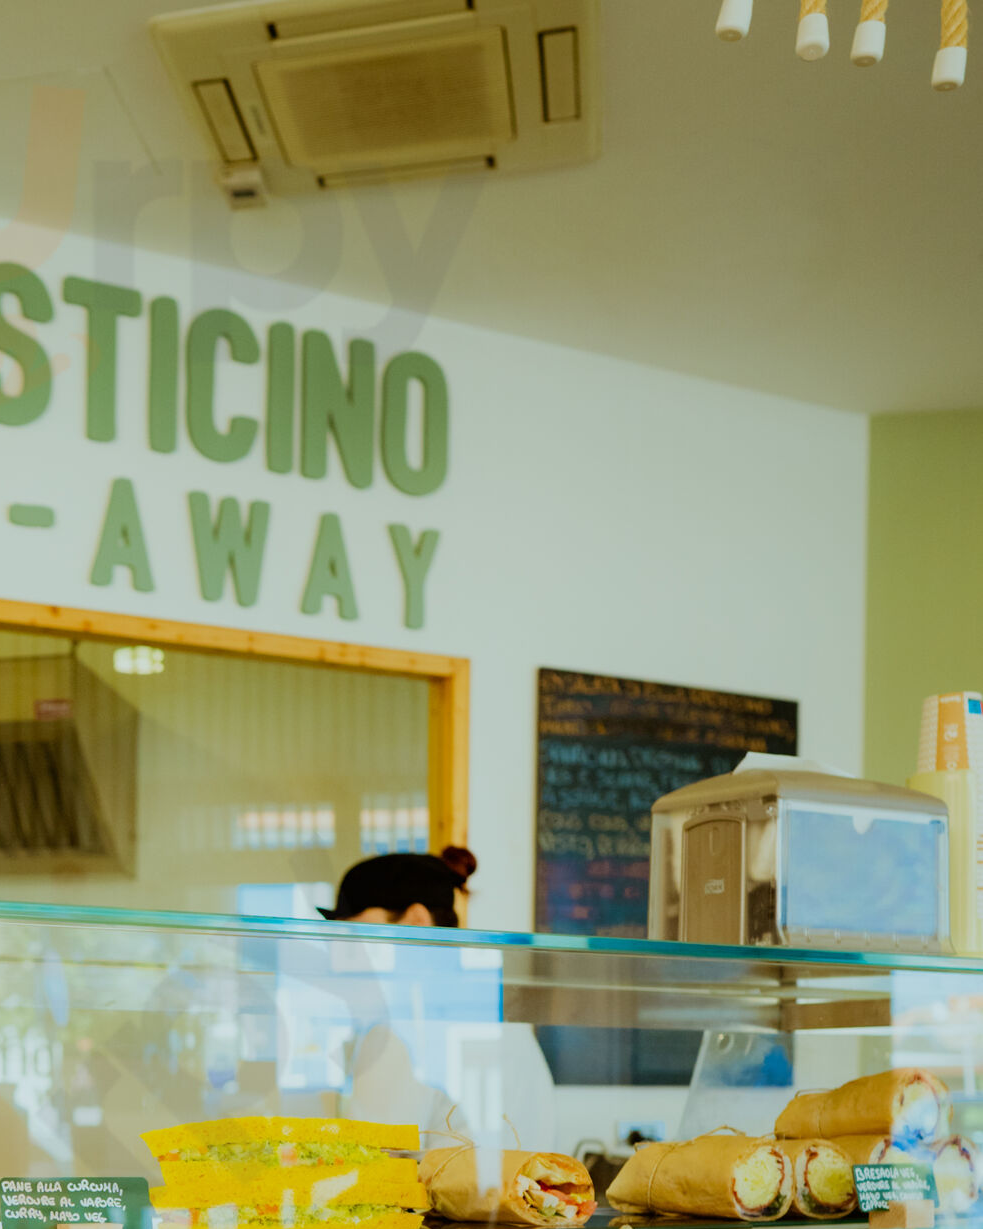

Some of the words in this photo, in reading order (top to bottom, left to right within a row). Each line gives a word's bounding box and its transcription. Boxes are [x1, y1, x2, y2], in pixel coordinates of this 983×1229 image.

[855, 1167, 899, 1181] BRESAOLA
[1, 1180, 32, 1193] PANE
[37, 1181, 63, 1193] ALLA
[67, 1179, 123, 1196] CURCUMA,
[2, 1194, 56, 1207] VERDURE
[60, 1196, 75, 1208] AL
[80, 1197, 127, 1212] VAPORE,
[5, 1207, 48, 1223] CURRY,
[50, 1211, 81, 1222] MAYO
[84, 1212, 108, 1224] VEG
